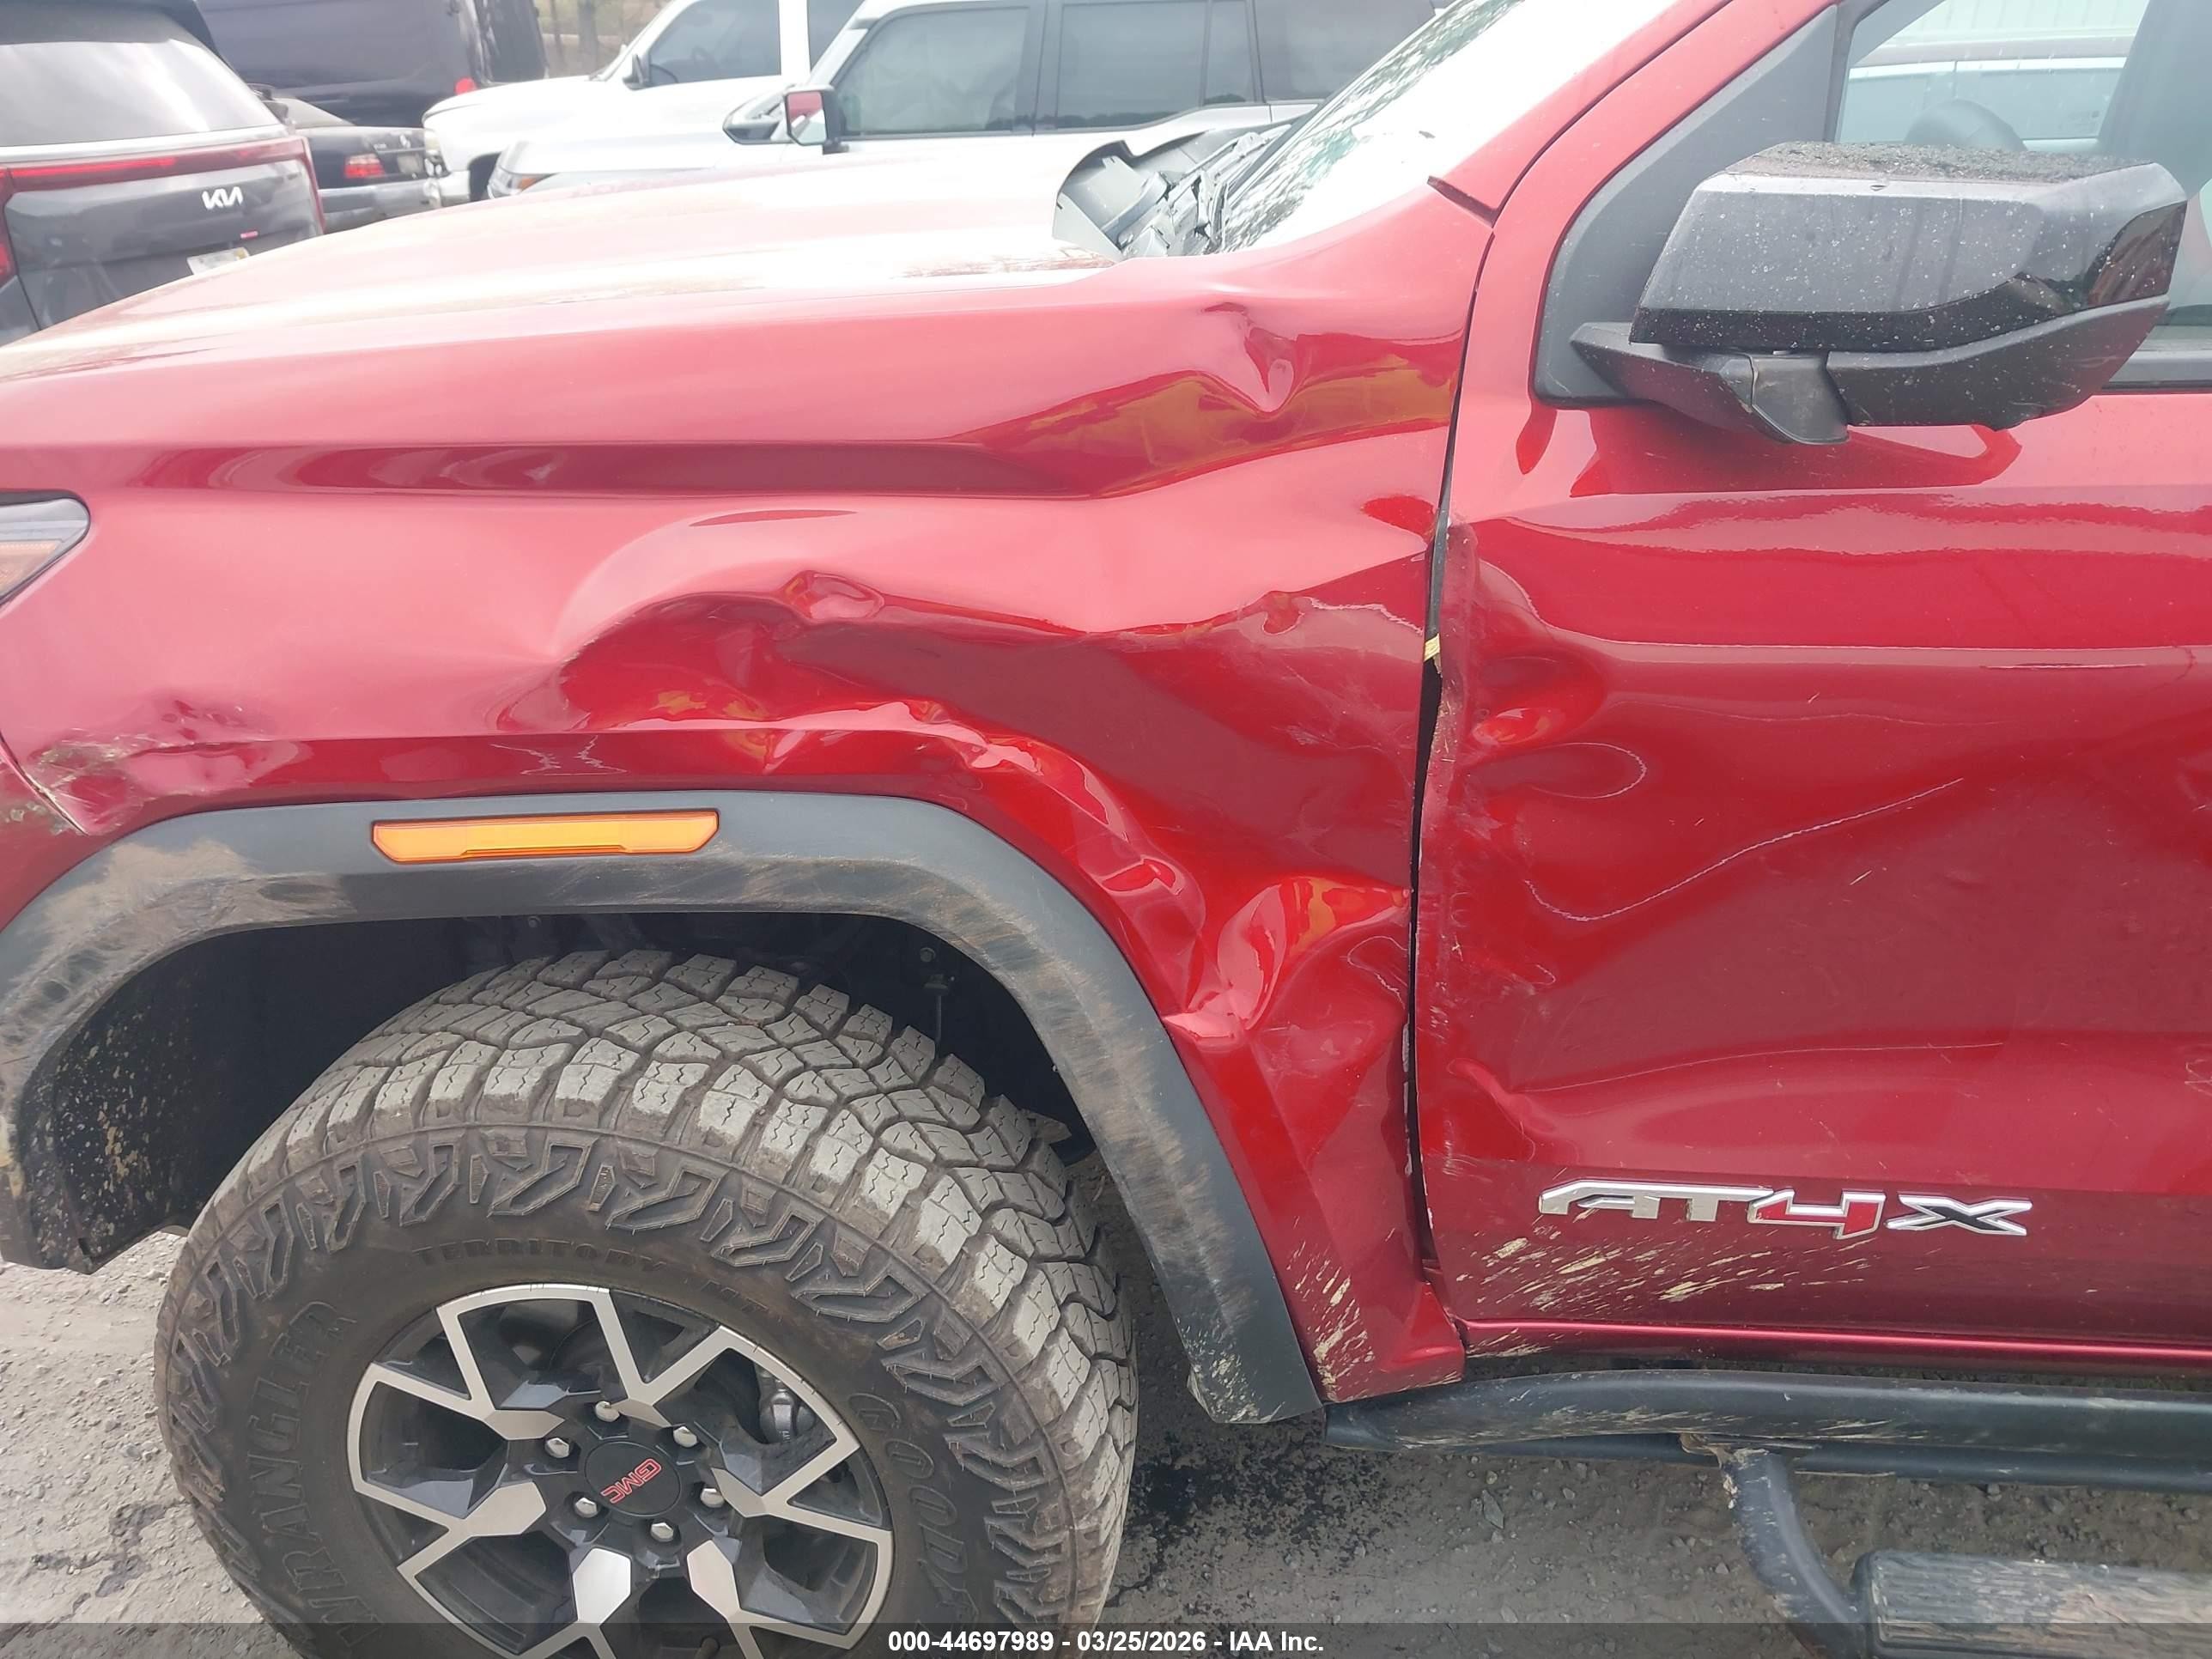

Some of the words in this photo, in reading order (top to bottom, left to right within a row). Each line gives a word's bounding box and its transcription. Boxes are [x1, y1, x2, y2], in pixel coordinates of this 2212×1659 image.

[1538, 1178, 2033, 1241] AT4X
[411, 1237, 667, 1273] TERRITORY
[600, 1458, 662, 1504] GMC
